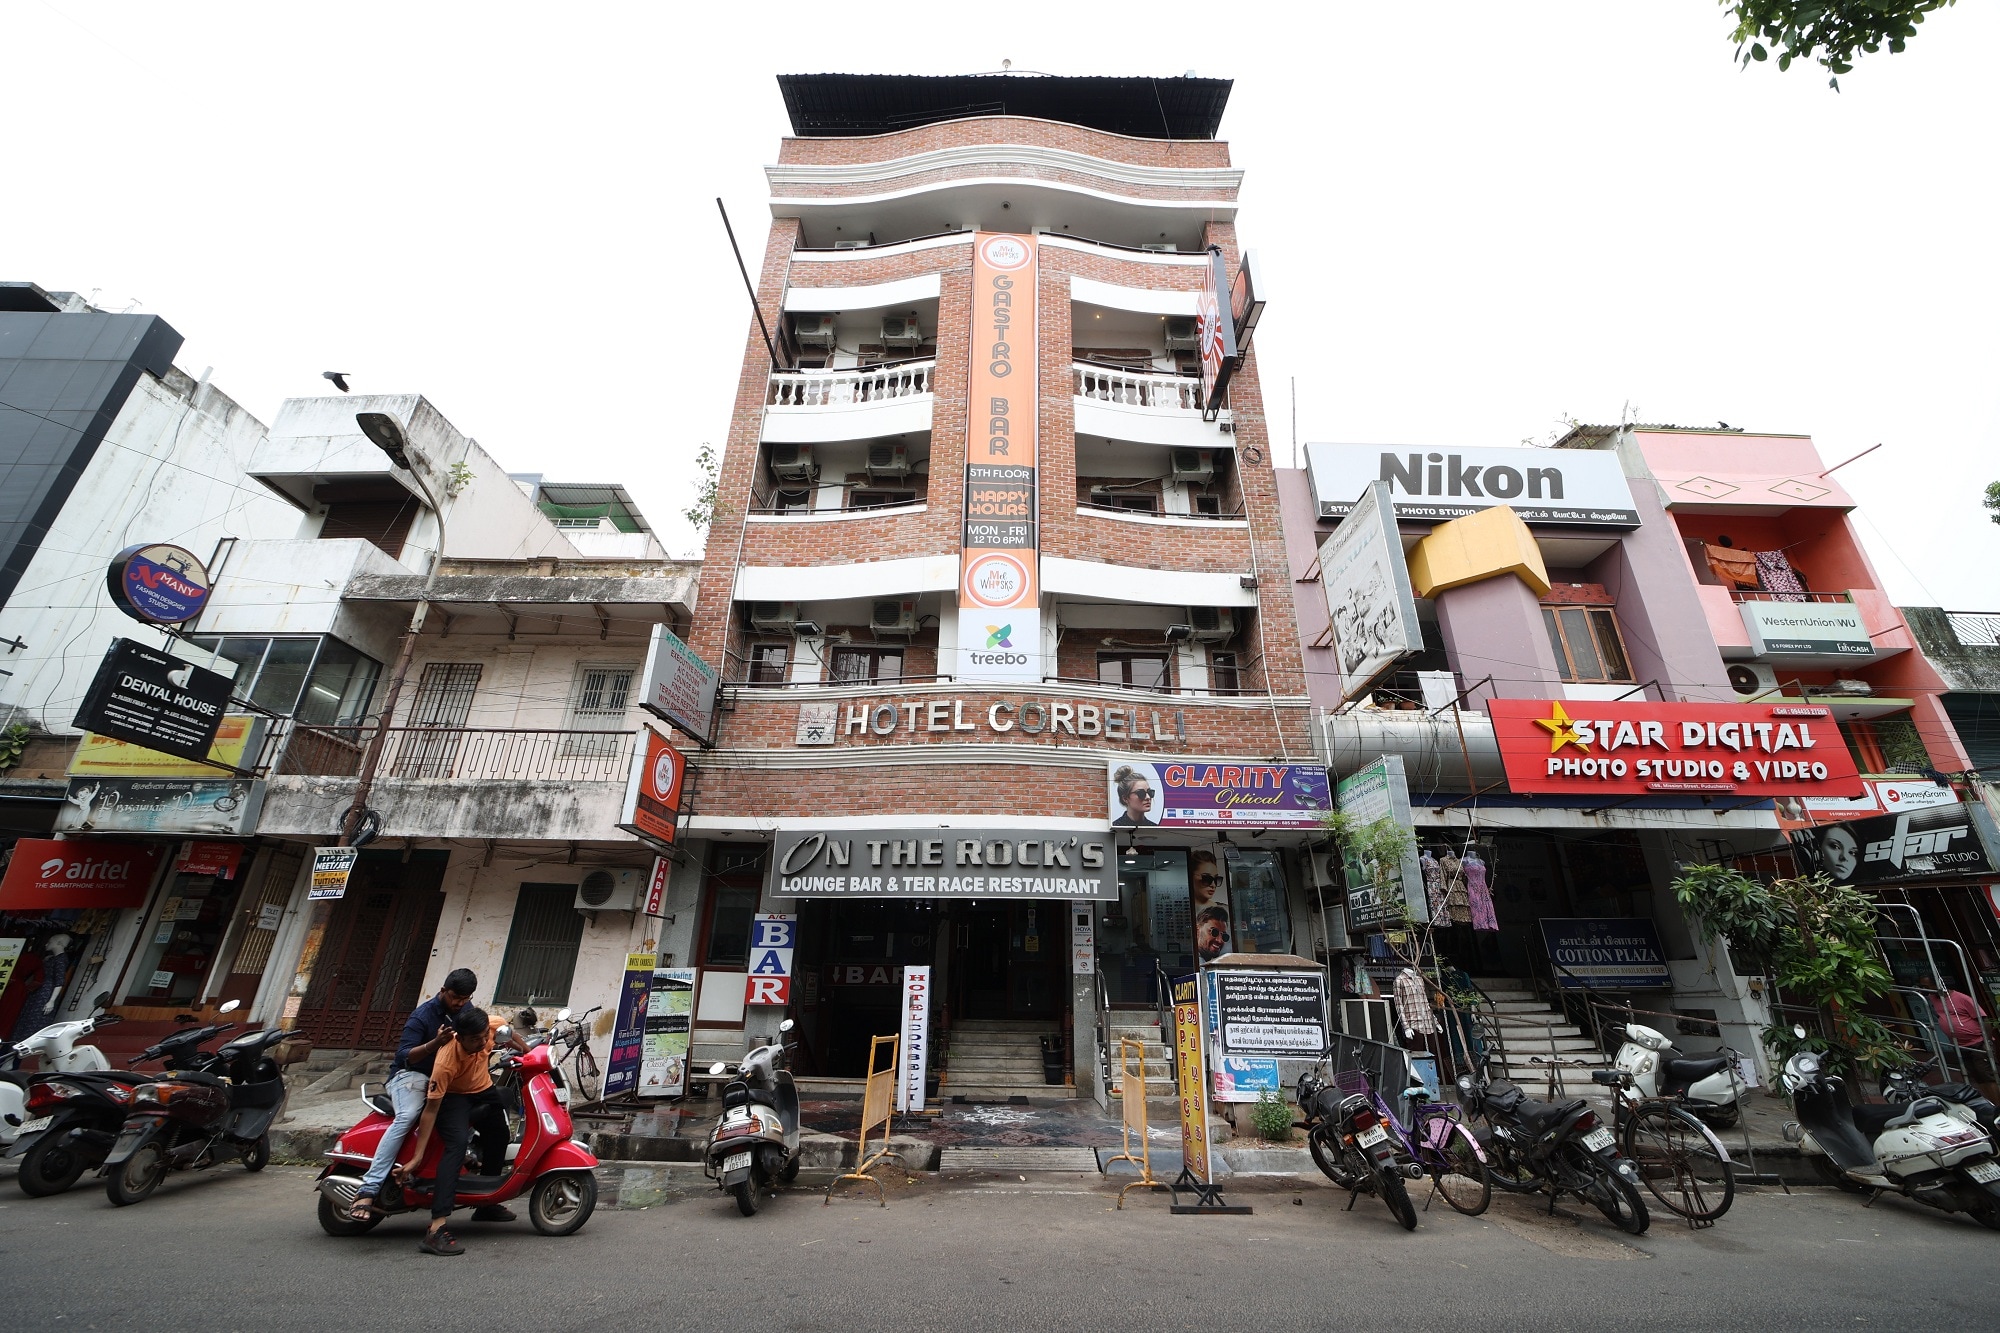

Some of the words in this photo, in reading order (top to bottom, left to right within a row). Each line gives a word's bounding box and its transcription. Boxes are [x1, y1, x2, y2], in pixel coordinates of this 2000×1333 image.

[989, 275, 1013, 378] GASTRO
[989, 397, 1010, 456] BAR
[970, 468, 991, 477] 5TH
[993, 469, 1030, 479] FLOOR
[1379, 452, 1564, 499] Nikon
[973, 490, 1029, 502] HAPPY
[969, 503, 1029, 516] HOURS
[1402, 507, 1436, 515] PHOTO
[1439, 508, 1476, 516] STUDIO
[968, 525, 998, 535] MON
[1009, 526, 1027, 536] FRI
[974, 536, 985, 544] 12
[986, 536, 1000, 544] TO
[1003, 536, 1024, 544] 6PM
[160, 573, 194, 596] MANY
[148, 597, 168, 610] STUDIO
[160, 596, 186, 611] DESIGNER
[1837, 619, 1856, 627] WU
[666, 633, 687, 656] HOTEL
[970, 652, 1027, 665] treebo
[121, 676, 172, 702] DENTAL
[174, 694, 217, 716] HOUSE
[659, 683, 681, 703] TERRACE
[671, 682, 682, 694] FINE
[658, 693, 670, 707] WITH
[845, 699, 976, 735] HOTEL
[988, 700, 1186, 740] CORBELLI
[1572, 720, 1670, 751] STAR
[1682, 721, 1817, 754] DIGITAL
[1164, 765, 1289, 788] CLARITY
[1546, 757, 1626, 780] PHOTO
[1636, 758, 1724, 780] STUDIO
[1733, 760, 1750, 781] &
[1753, 760, 1828, 782] VIDEO
[1215, 788, 1284, 809] Optical
[1900, 791, 1947, 799] MoneyGram
[779, 832, 853, 876] ON
[866, 838, 943, 866] THE
[956, 835, 1105, 869] ROCK'S
[1942, 851, 1980, 863] STUDIO
[66, 857, 130, 880] airtel
[316, 861, 351, 870] NEET/JEE
[314, 877, 345, 885] TUITIONS
[648, 860, 669, 913] TABAC
[781, 877, 845, 892] LOUNGE
[850, 877, 882, 892] BAR
[886, 877, 898, 892] &
[988, 878, 1101, 894] RESTAURANT
[1560, 935, 1601, 945] காட்டன்
[750, 922, 790, 1004] BAR
[1556, 948, 1613, 962] COTTON
[1614, 948, 1660, 962] PLAZA
[1174, 981, 1196, 1001] CLARITY
[1178, 1007, 1193, 1166] OPTICAL
